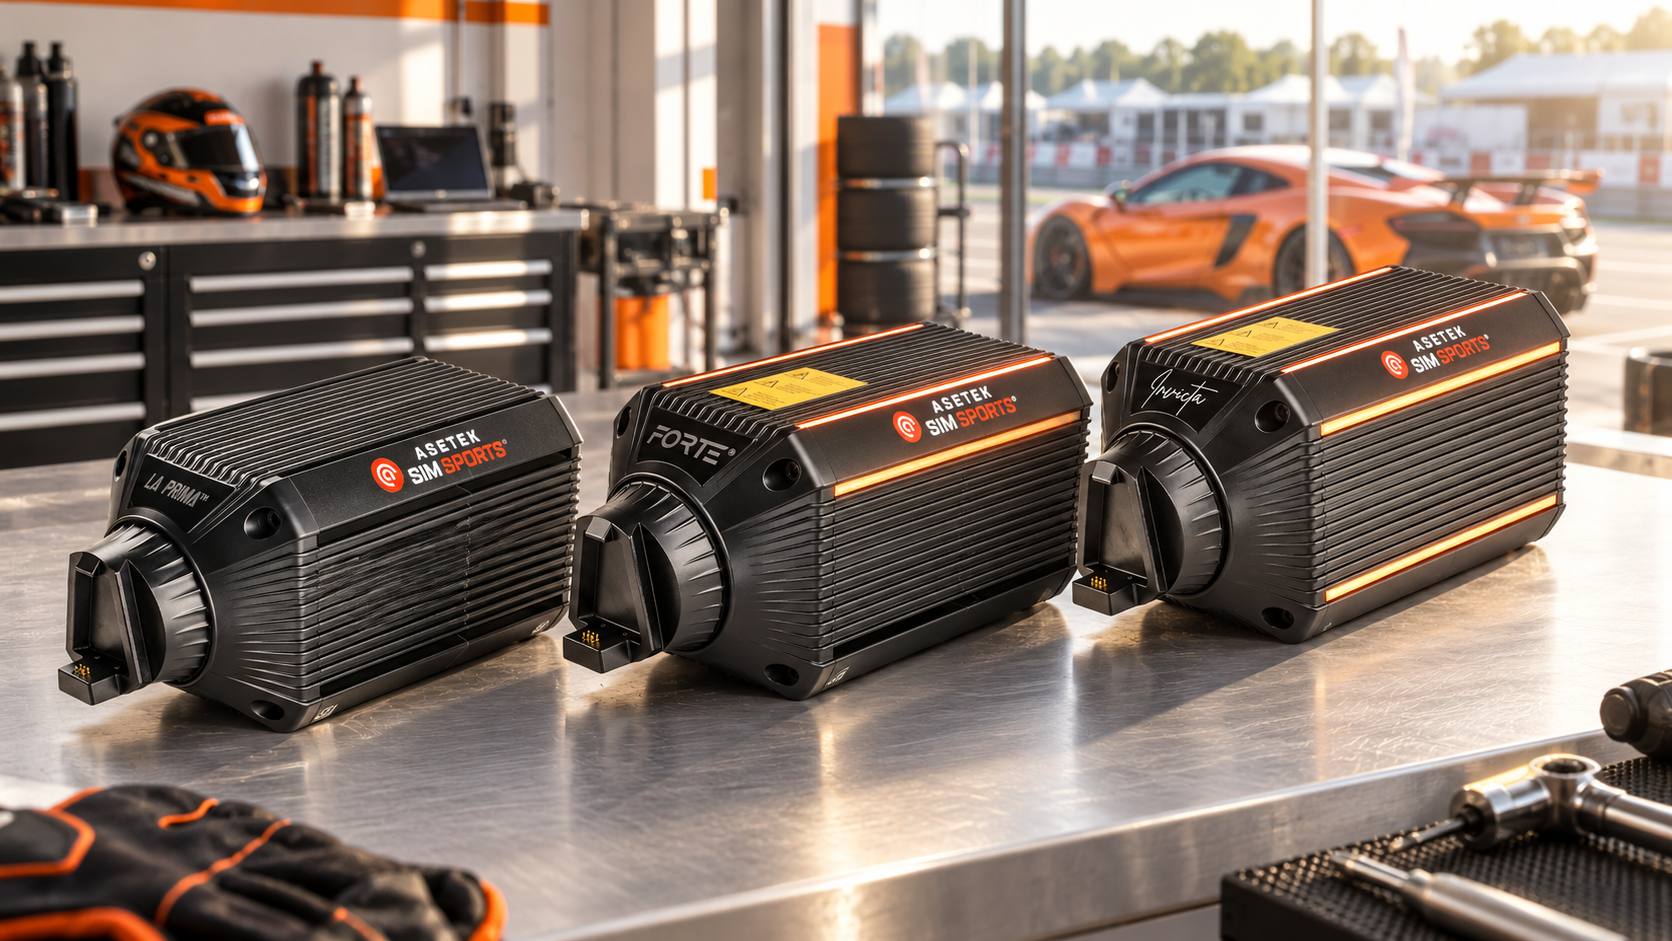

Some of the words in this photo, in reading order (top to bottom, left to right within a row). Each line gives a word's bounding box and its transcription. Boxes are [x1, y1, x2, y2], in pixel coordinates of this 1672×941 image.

[1412, 325, 1467, 352] ASETEK
[1410, 352, 1440, 373] SIM
[931, 385, 992, 413] ASETEK
[1141, 368, 1218, 416] Invicta
[925, 414, 958, 436] SIM
[414, 429, 481, 460] ASETEK
[143, 472, 165, 492] LA
[407, 460, 443, 485] SIM
